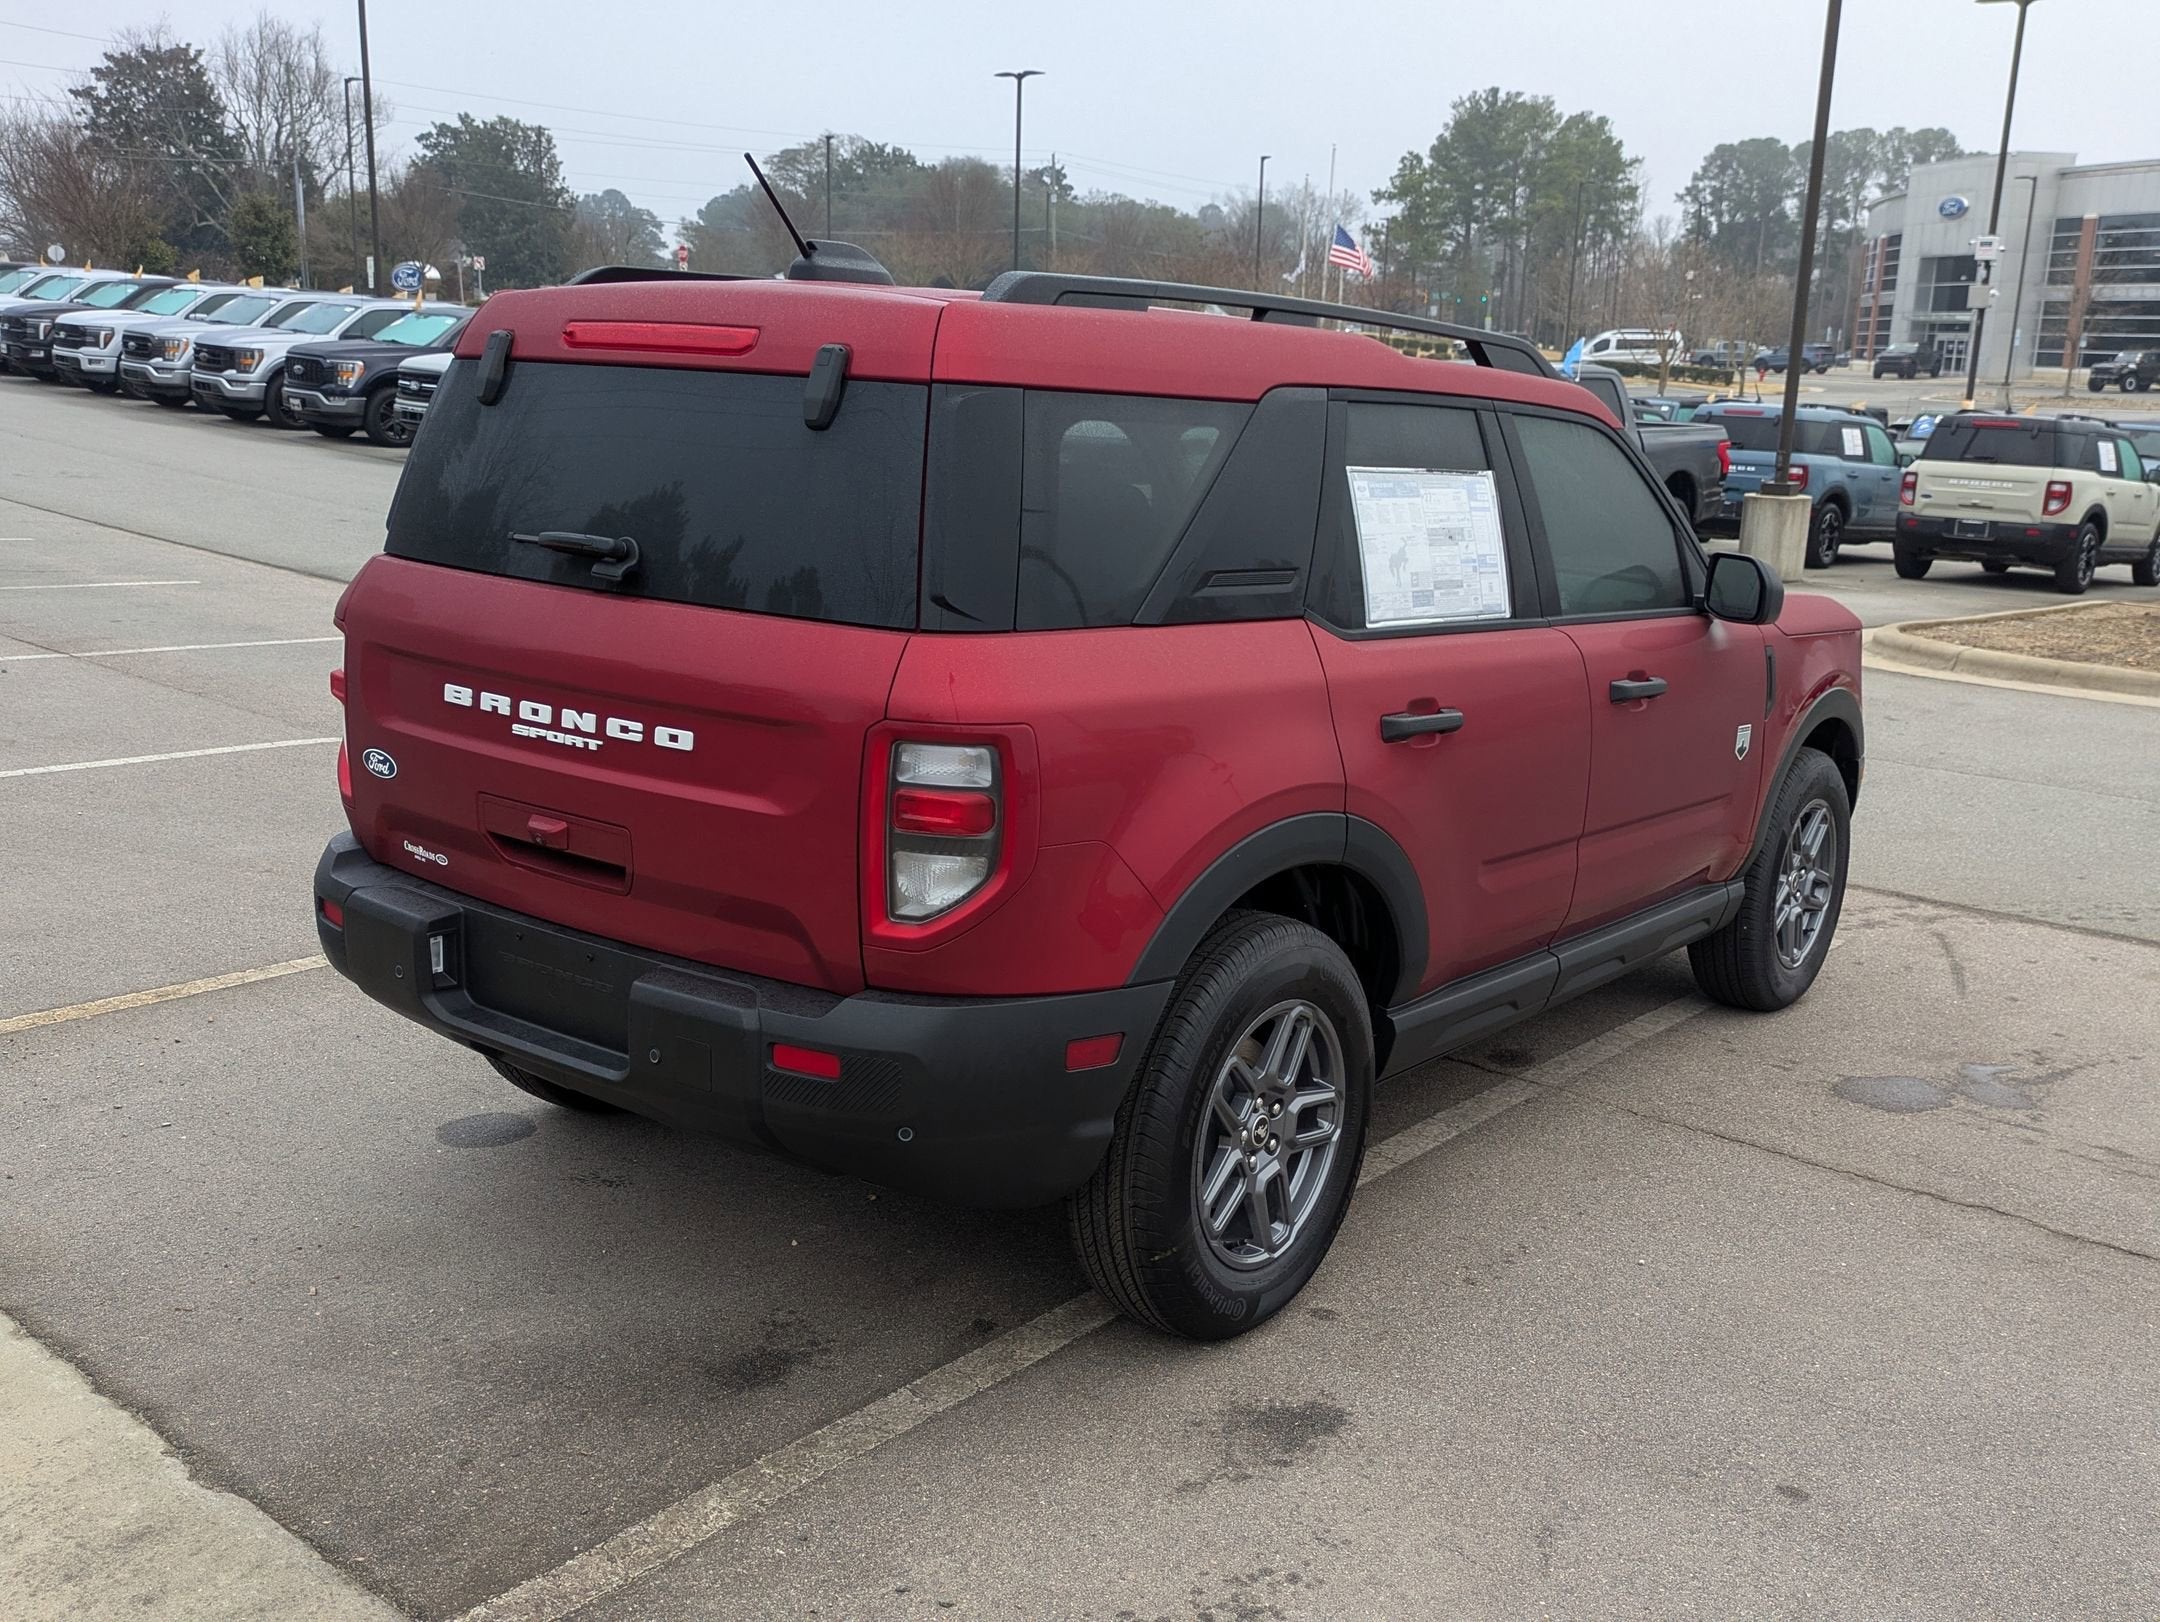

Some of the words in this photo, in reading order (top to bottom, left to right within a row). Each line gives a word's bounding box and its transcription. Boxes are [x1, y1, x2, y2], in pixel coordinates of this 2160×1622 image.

[397, 268, 420, 287] Ford
[444, 683, 694, 751] BRONCO
[511, 723, 604, 751] SPORT
[368, 752, 390, 775] Ford
[1184, 1258, 1247, 1321] Continental
